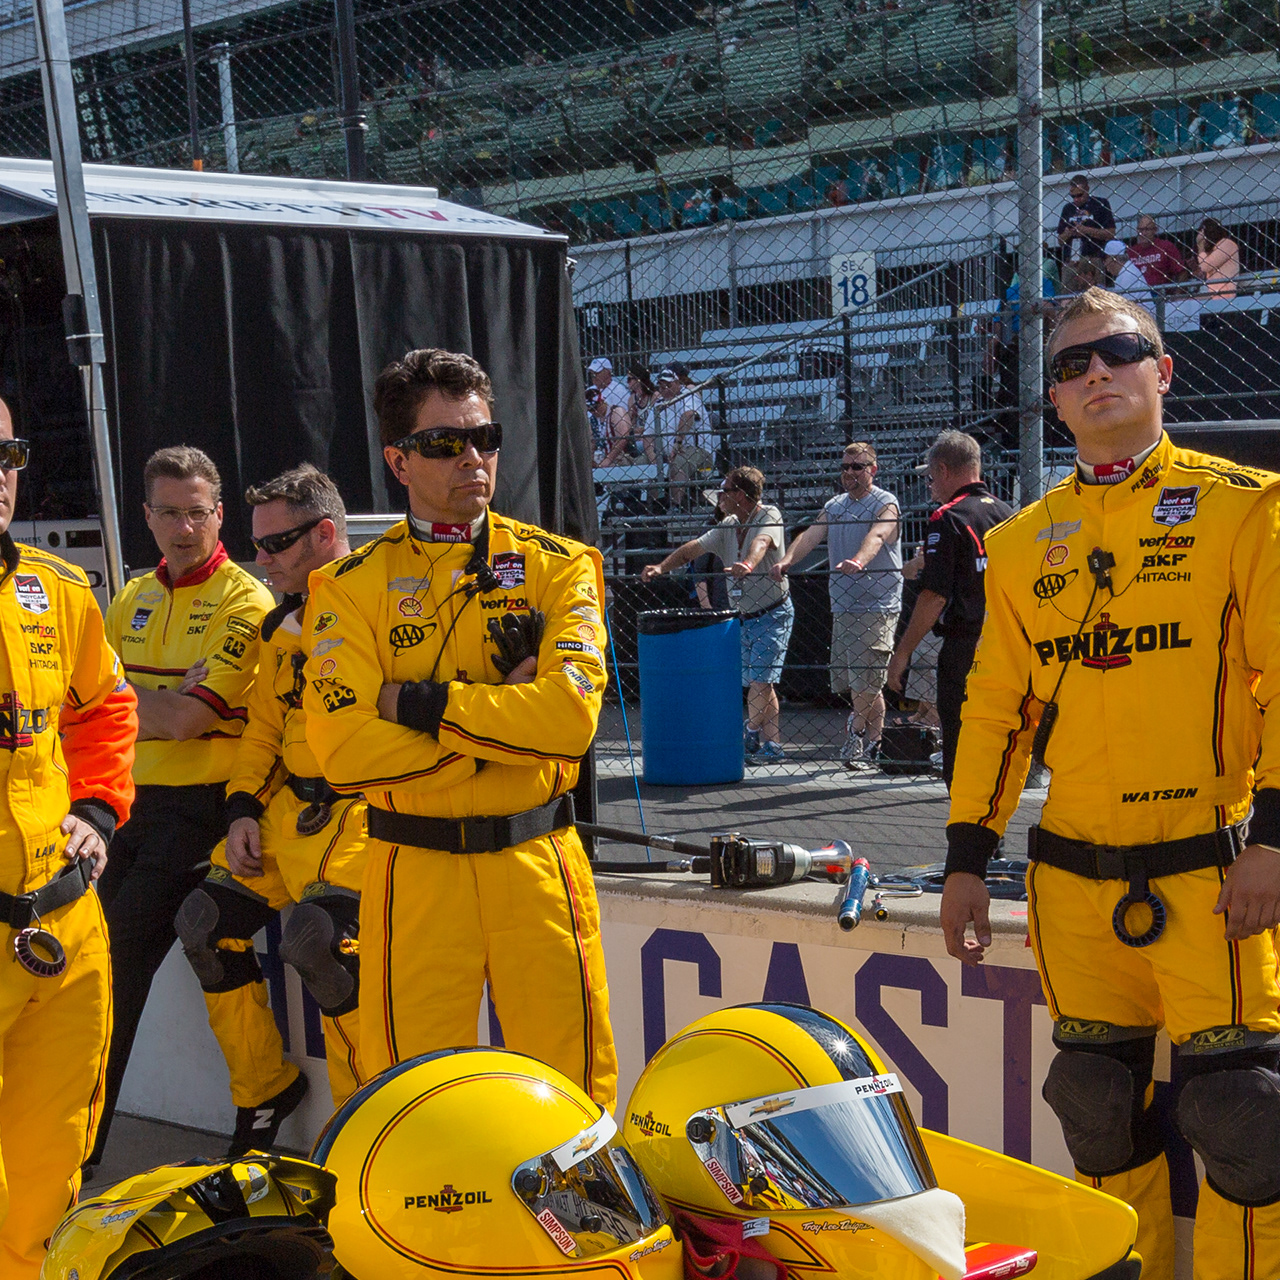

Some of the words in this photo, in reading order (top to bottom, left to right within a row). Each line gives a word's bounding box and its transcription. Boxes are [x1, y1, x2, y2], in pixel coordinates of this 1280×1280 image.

[837, 274, 869, 307] 18
[1131, 463, 1164, 493] PENNZOIL
[1208, 461, 1268, 479] Firestone
[1139, 534, 1195, 549] verizon
[1142, 554, 1187, 567] SKF
[1137, 571, 1191, 583] HITACHI
[1038, 577, 1065, 597] AAA
[20, 621, 56, 638] verizon
[187, 624, 207, 635] SKF
[394, 626, 420, 644] AAA
[30, 642, 54, 655] SKF
[557, 642, 582, 650] HINO
[1033, 621, 1192, 667] PENNZOIL
[29, 658, 59, 670] HITACHI
[212, 653, 243, 672] Snap-on
[323, 685, 357, 712] PPG
[1122, 787, 1199, 804] WATSON
[35, 842, 58, 859] LAW
[854, 1077, 894, 1095] PENNZOIL
[629, 1111, 672, 1138] PENNZOIL
[706, 1159, 740, 1202] SIMPSON
[404, 1190, 493, 1210] PENNZOIL
[539, 1210, 574, 1252] SIMPSON
[821, 1221, 838, 1231] Lee
